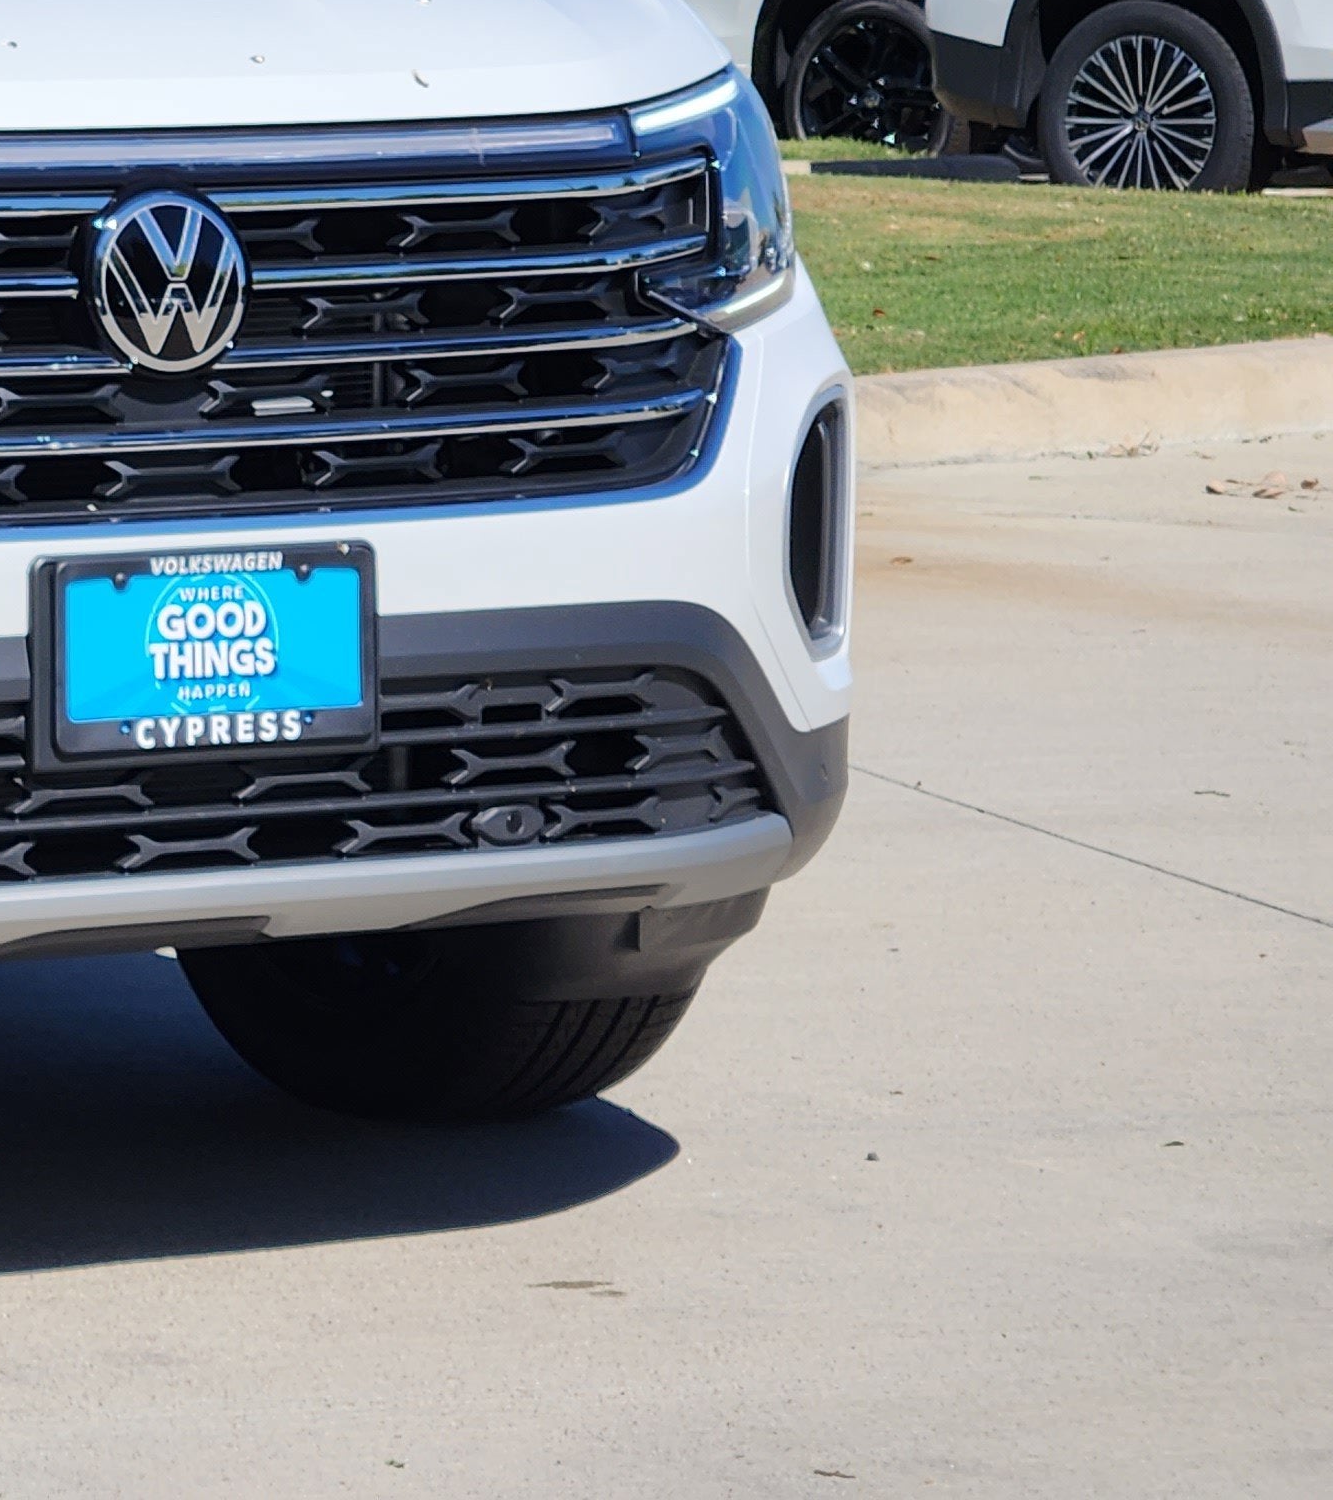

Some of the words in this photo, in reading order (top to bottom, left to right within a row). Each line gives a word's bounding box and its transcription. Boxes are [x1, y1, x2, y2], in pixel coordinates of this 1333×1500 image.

[150, 551, 284, 576] VOLKSWAGEN
[180, 585, 245, 602] WHERE
[156, 600, 267, 641] GOOD
[148, 637, 276, 680] THINGS
[177, 680, 251, 701] HAPPEN
[135, 710, 303, 750] CYPRESS
